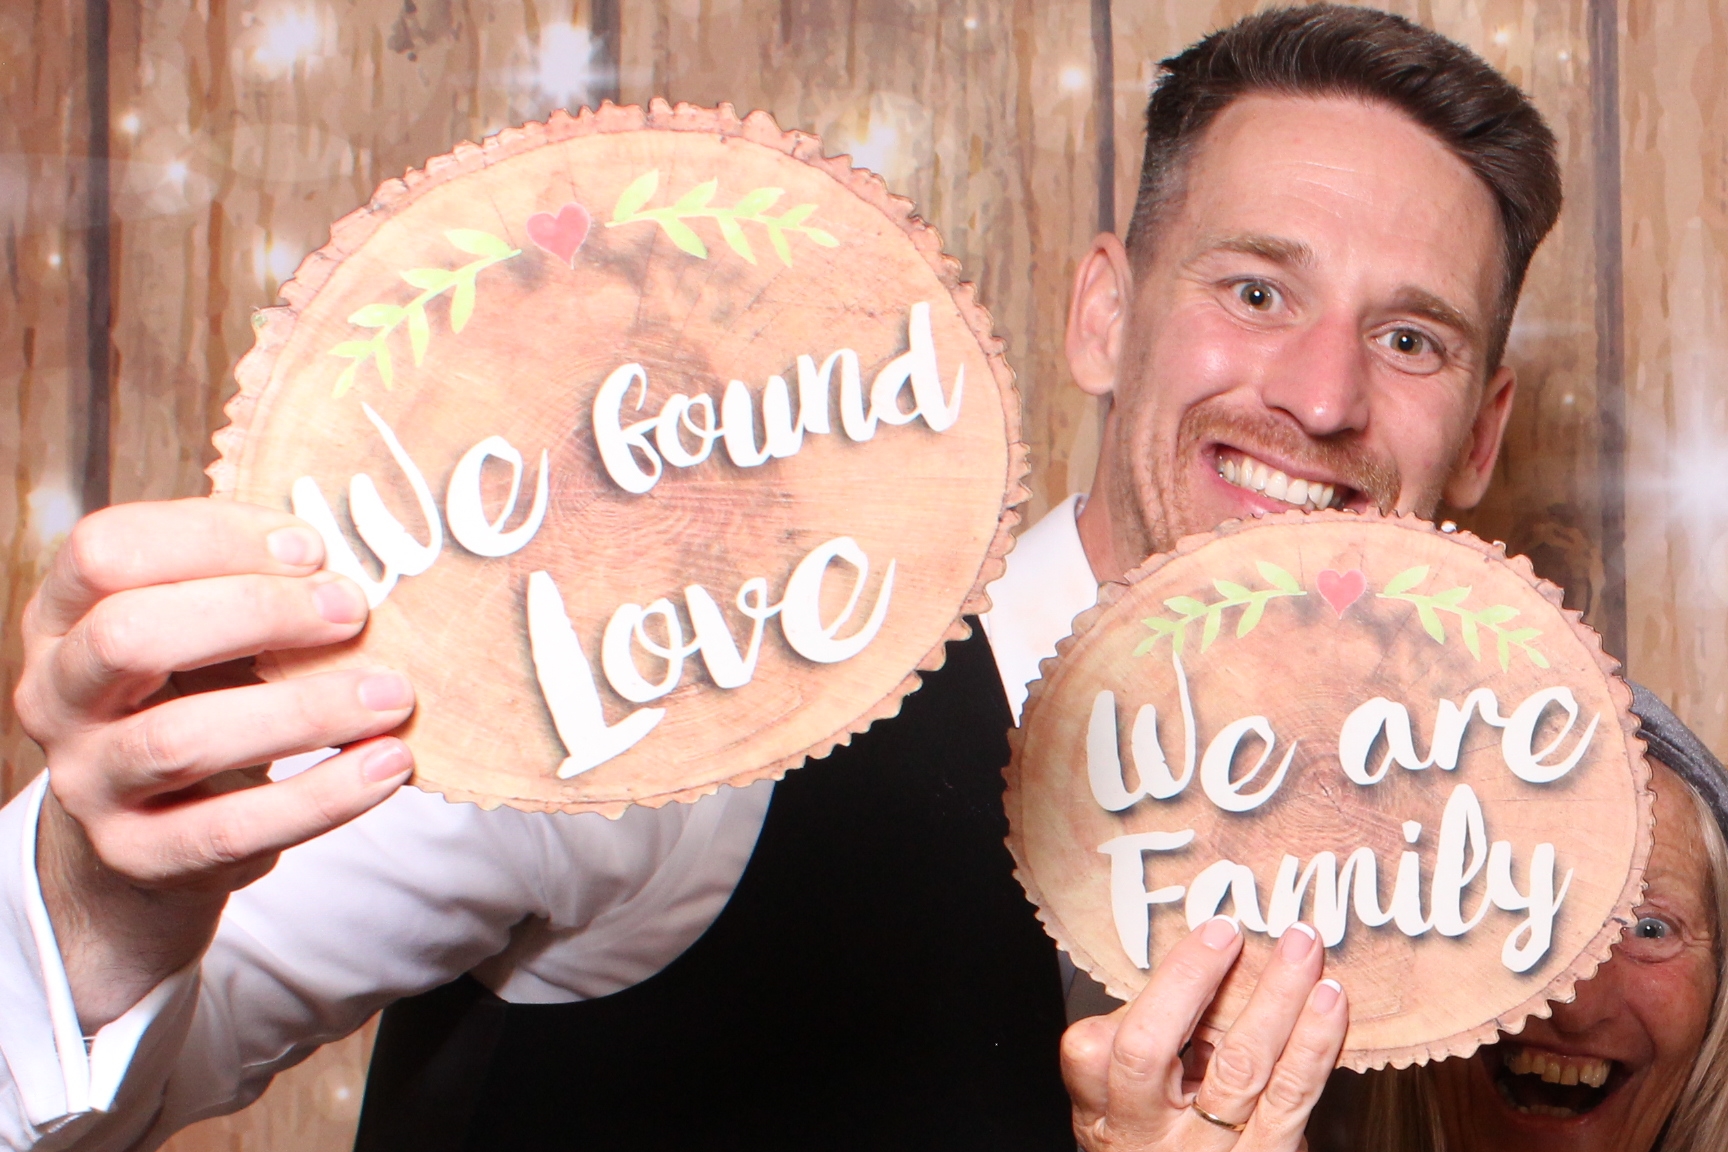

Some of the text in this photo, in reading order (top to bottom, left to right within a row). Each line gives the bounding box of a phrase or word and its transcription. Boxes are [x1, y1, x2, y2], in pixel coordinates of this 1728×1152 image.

[292, 302, 965, 610] We found
[528, 535, 896, 780] Love
[1087, 652, 1601, 812] We are
[1097, 783, 1574, 973] Family
